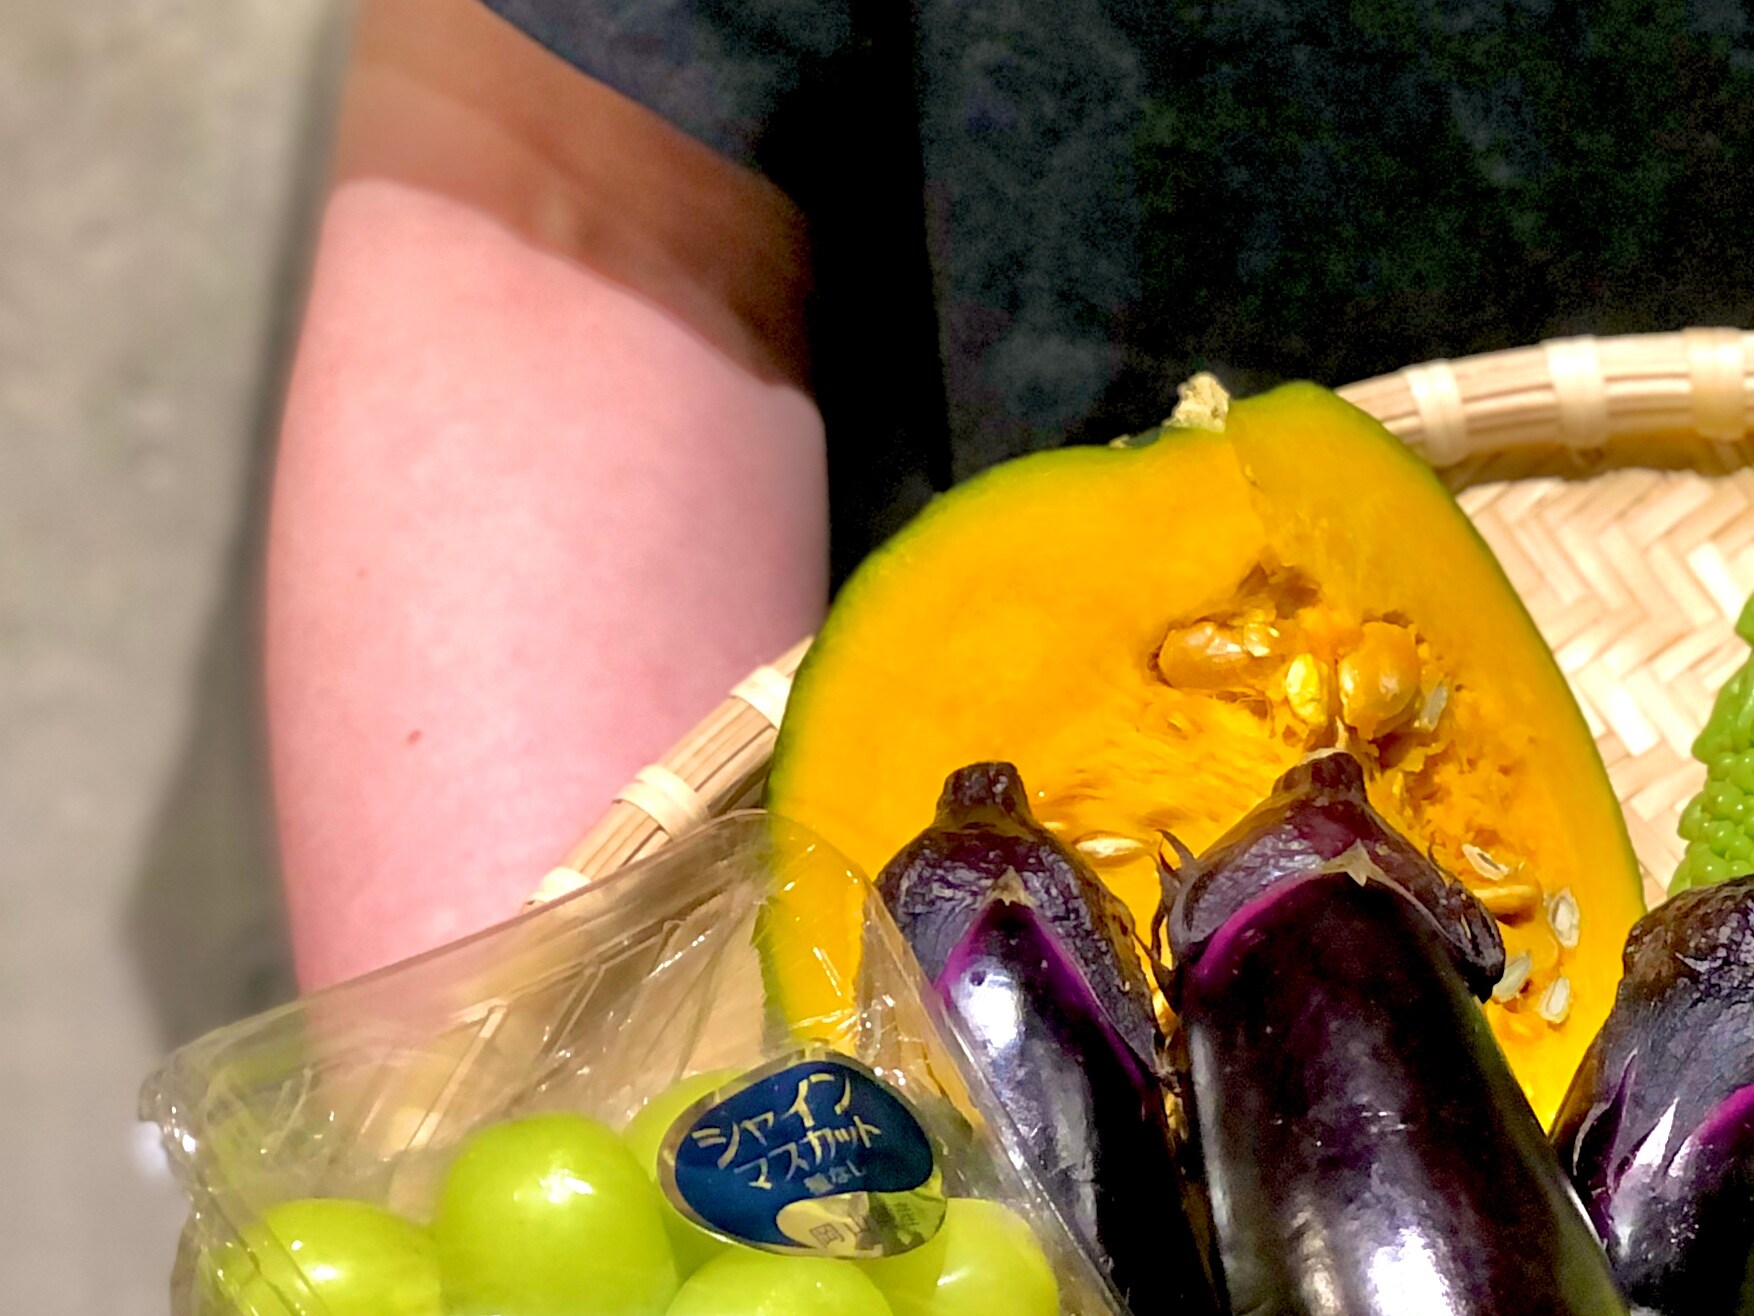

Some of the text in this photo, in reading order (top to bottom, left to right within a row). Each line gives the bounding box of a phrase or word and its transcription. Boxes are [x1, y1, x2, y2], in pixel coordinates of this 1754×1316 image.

[691, 1072, 852, 1169] シャイン
[734, 1115, 882, 1190] マスカット
